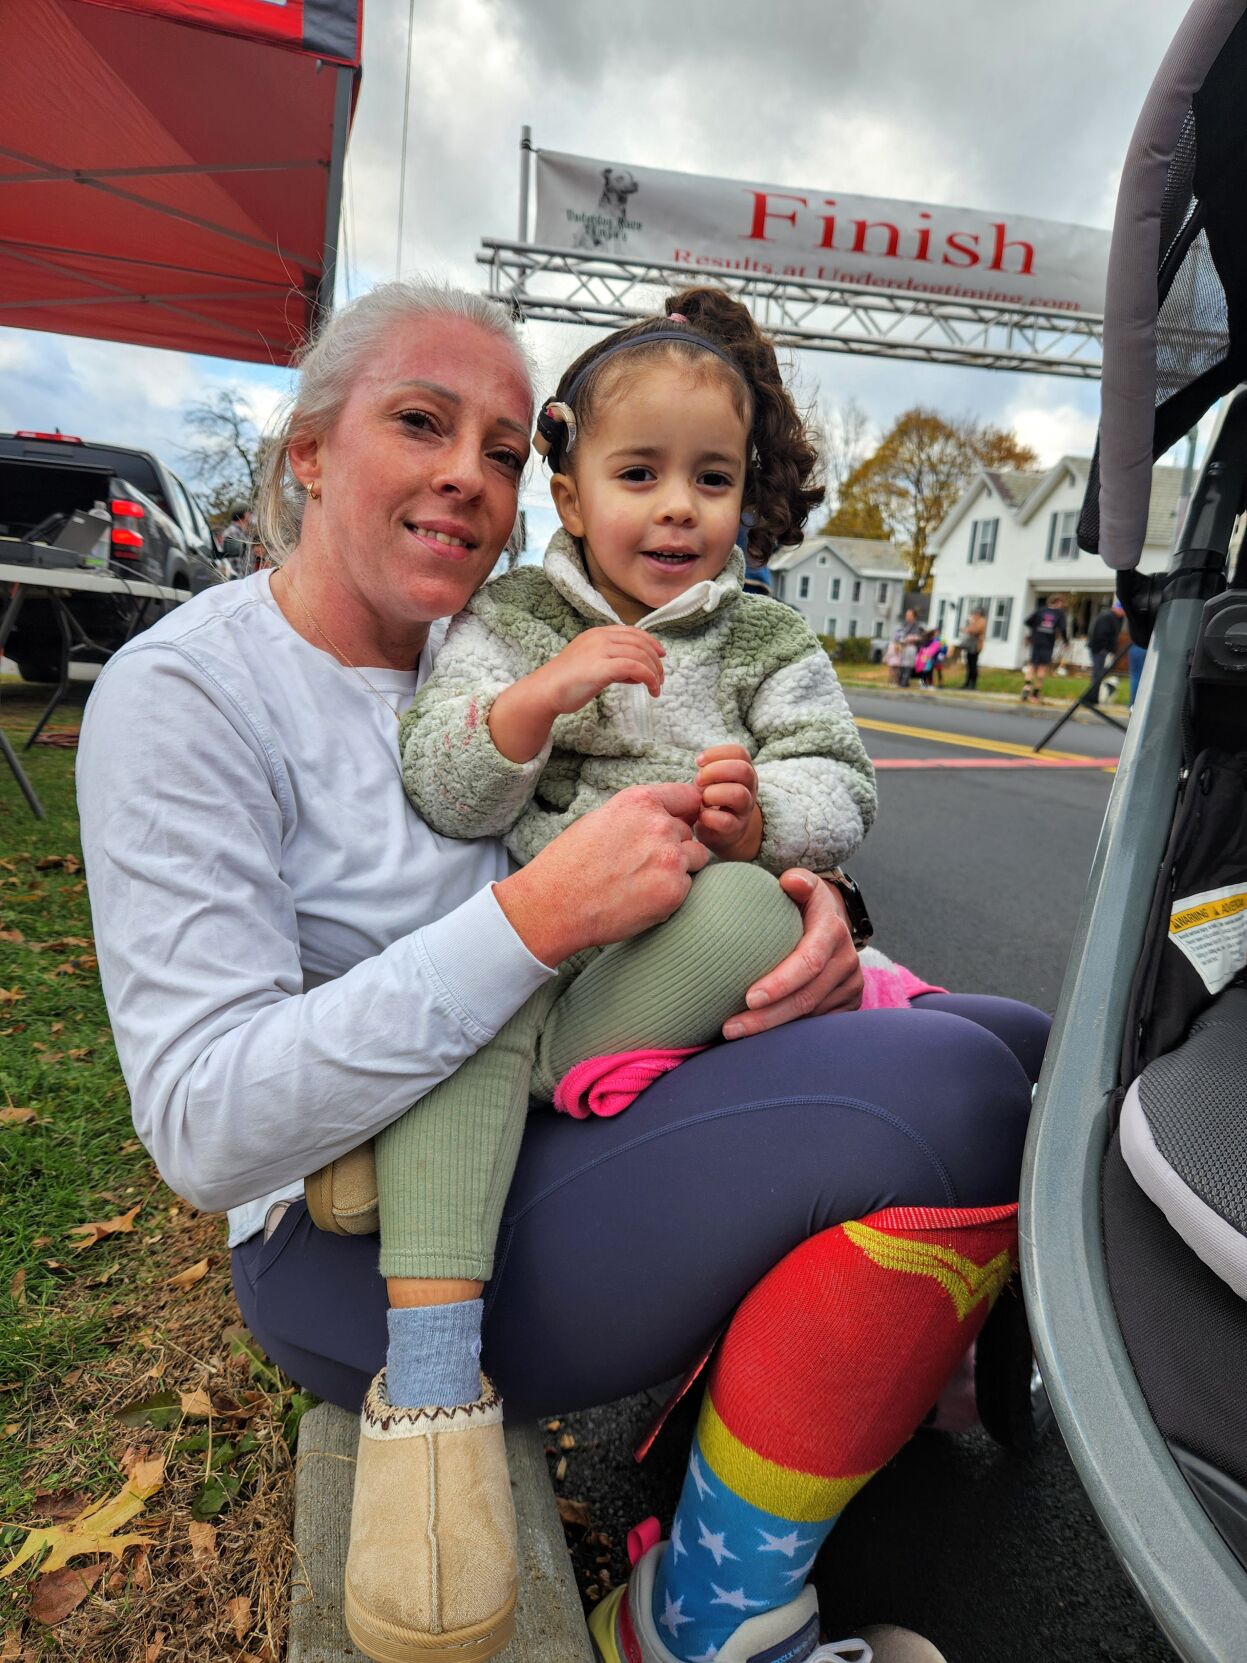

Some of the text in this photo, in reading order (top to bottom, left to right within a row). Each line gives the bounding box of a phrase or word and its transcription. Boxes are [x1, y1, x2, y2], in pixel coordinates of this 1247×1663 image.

[739, 189, 1036, 276] Finish
[673, 247, 774, 274] Results
[782, 262, 806, 278] at
[1176, 907, 1209, 927] WARNING
